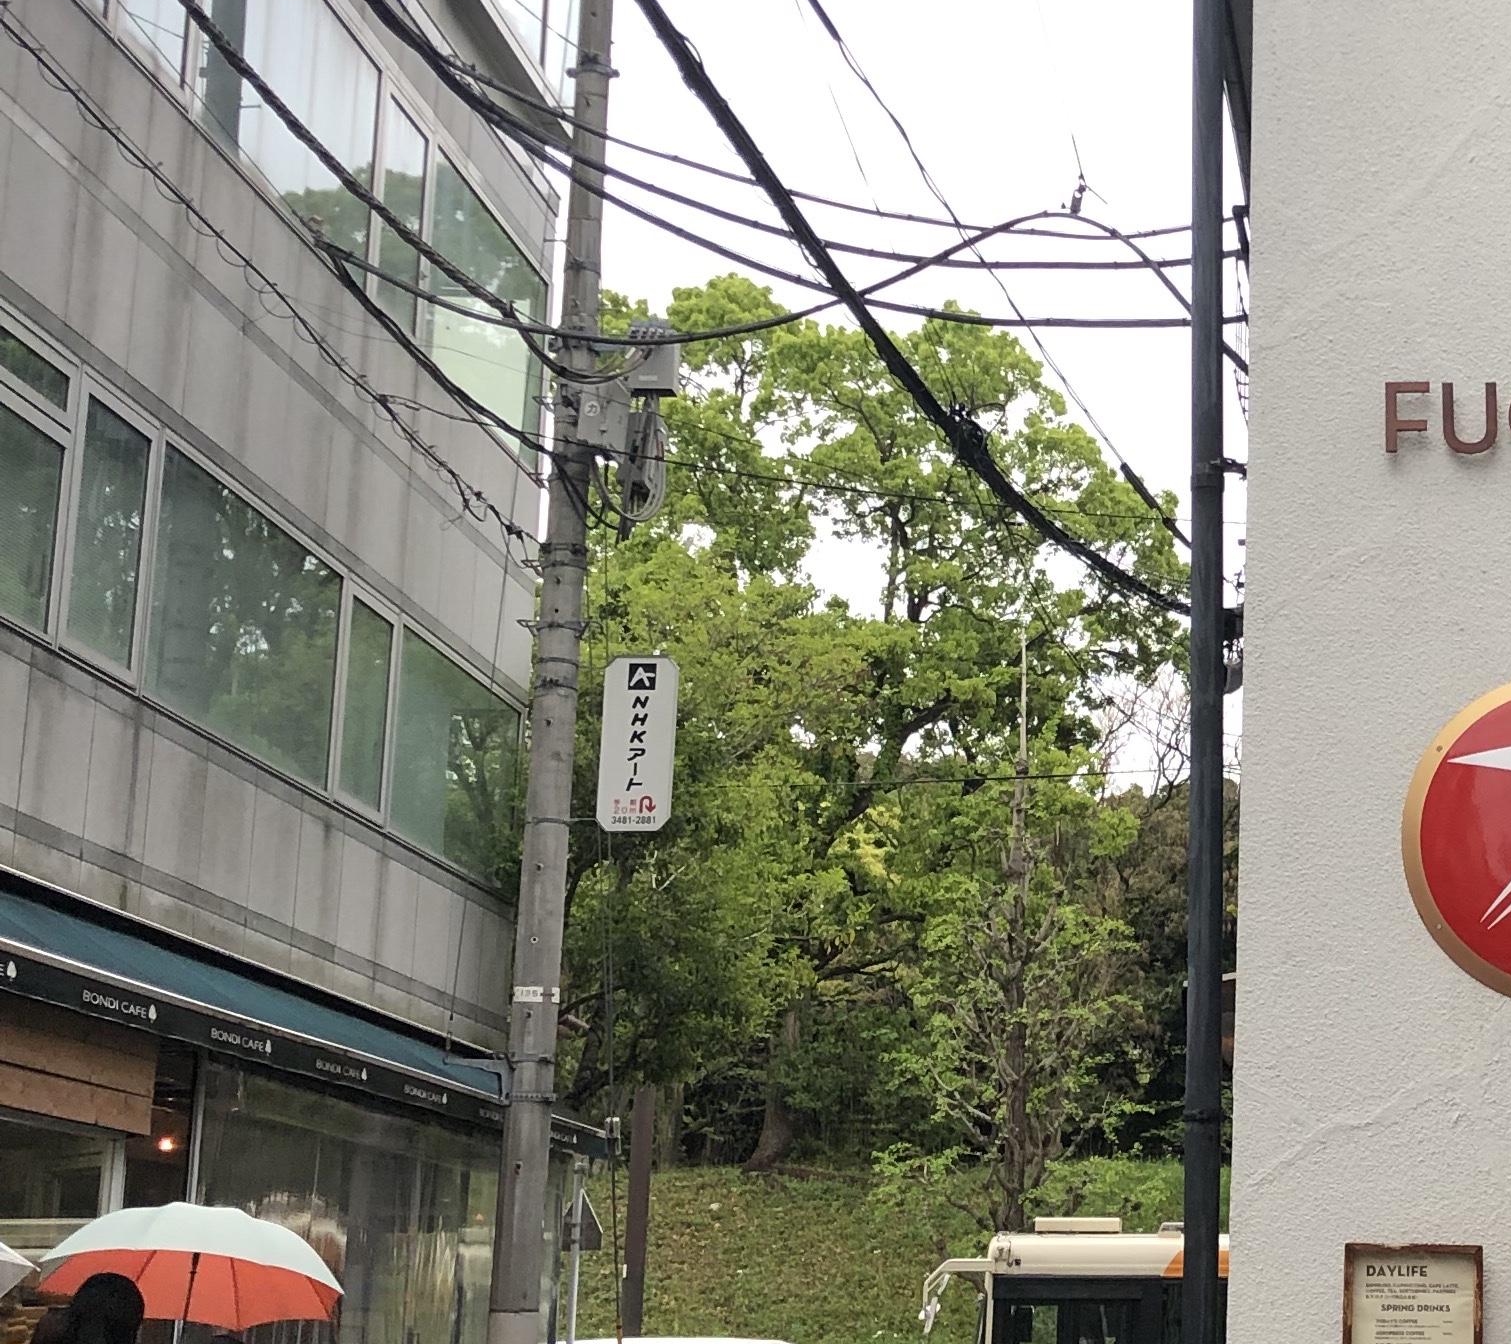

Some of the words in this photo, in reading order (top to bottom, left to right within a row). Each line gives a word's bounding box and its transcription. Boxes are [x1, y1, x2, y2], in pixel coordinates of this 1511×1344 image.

[626, 695, 650, 792] NHKアート
[82, 989, 119, 1010] BONDI
[120, 1001, 147, 1019] CAFE
[210, 1027, 241, 1045] BONDI
[242, 1037, 264, 1053] CAFE
[315, 1058, 342, 1074] BONDI
[342, 1066, 361, 1081] CAFE
[1366, 1265, 1428, 1277] DAYLIFE
[1381, 1304, 1415, 1312] SPRING
[1417, 1304, 1451, 1312] DRINKS
